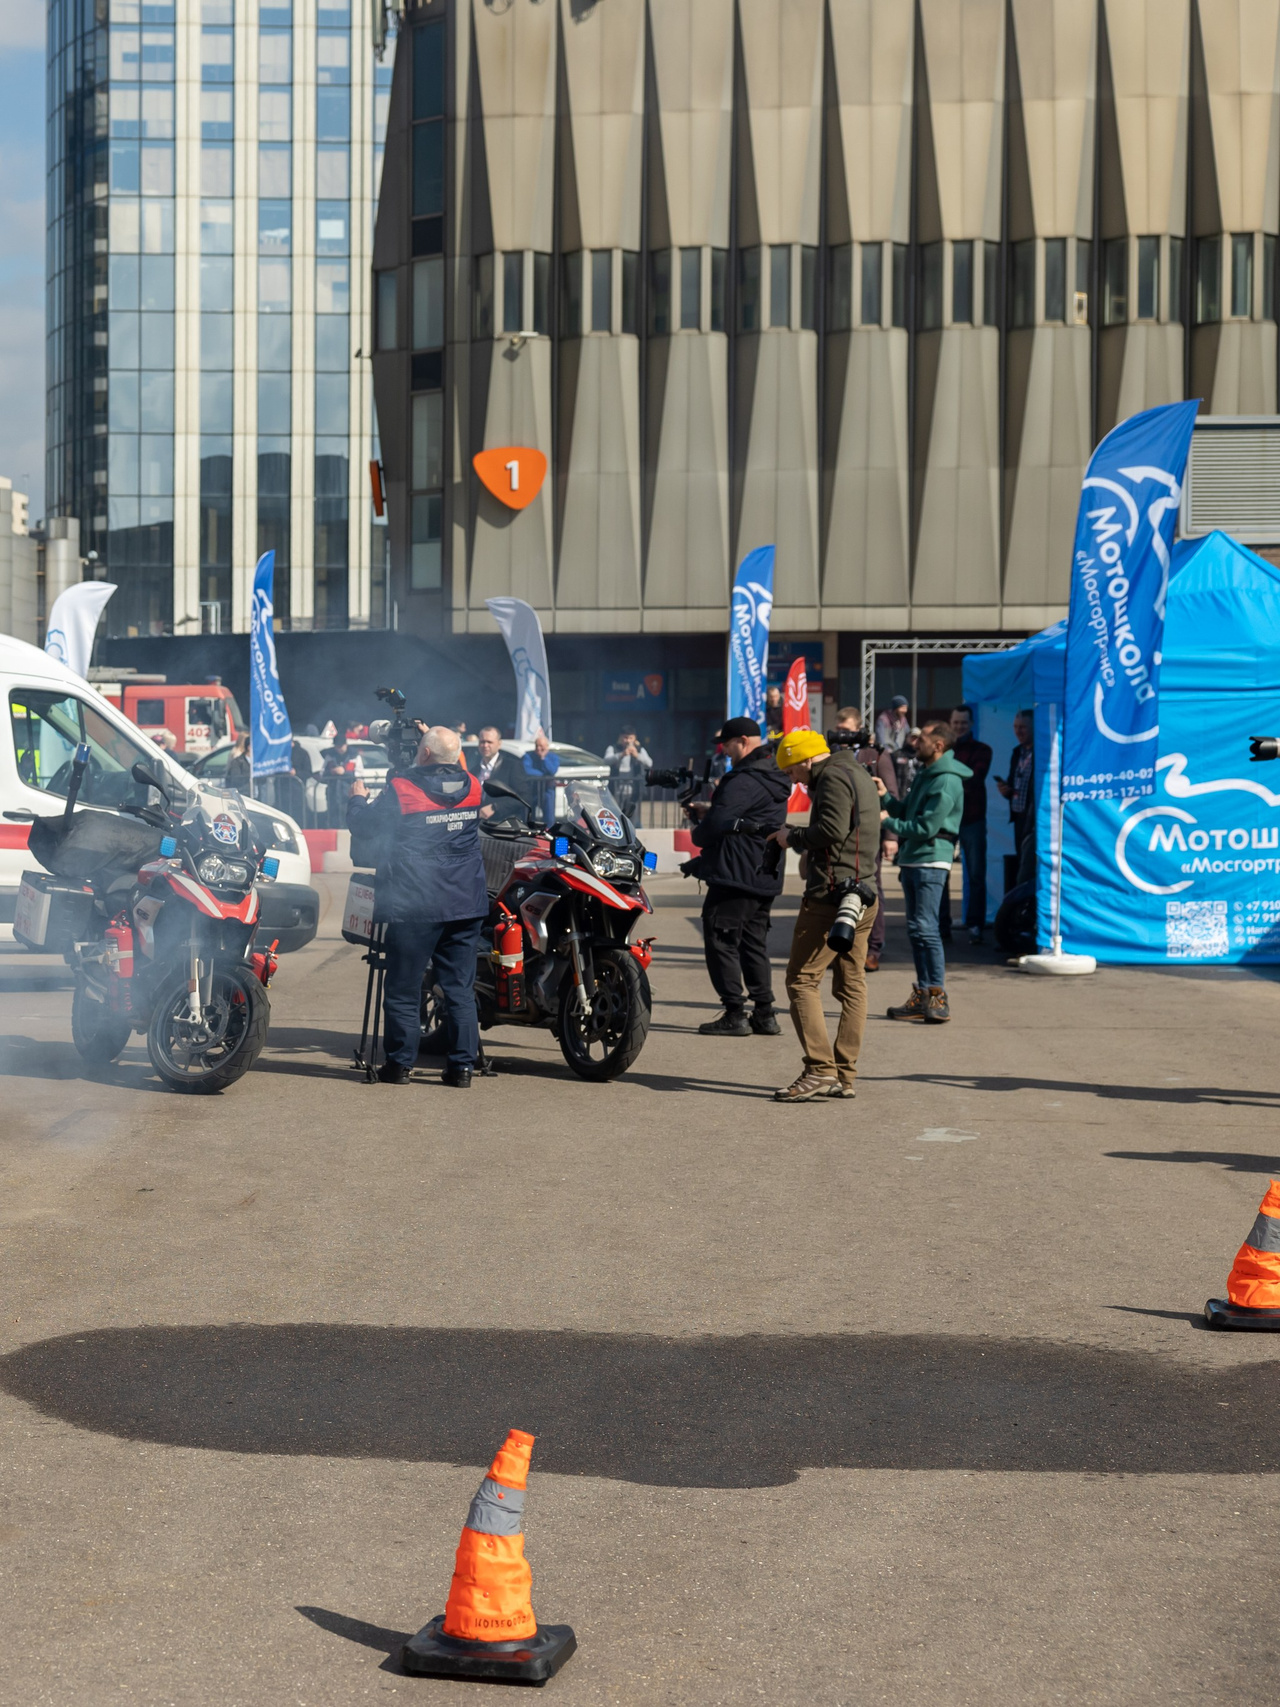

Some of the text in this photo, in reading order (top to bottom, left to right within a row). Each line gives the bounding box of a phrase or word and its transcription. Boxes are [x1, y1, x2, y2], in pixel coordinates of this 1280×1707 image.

[505, 460, 519, 490] 1
[1086, 506, 1156, 705] Мотошкола
[188, 727, 211, 738] 402
